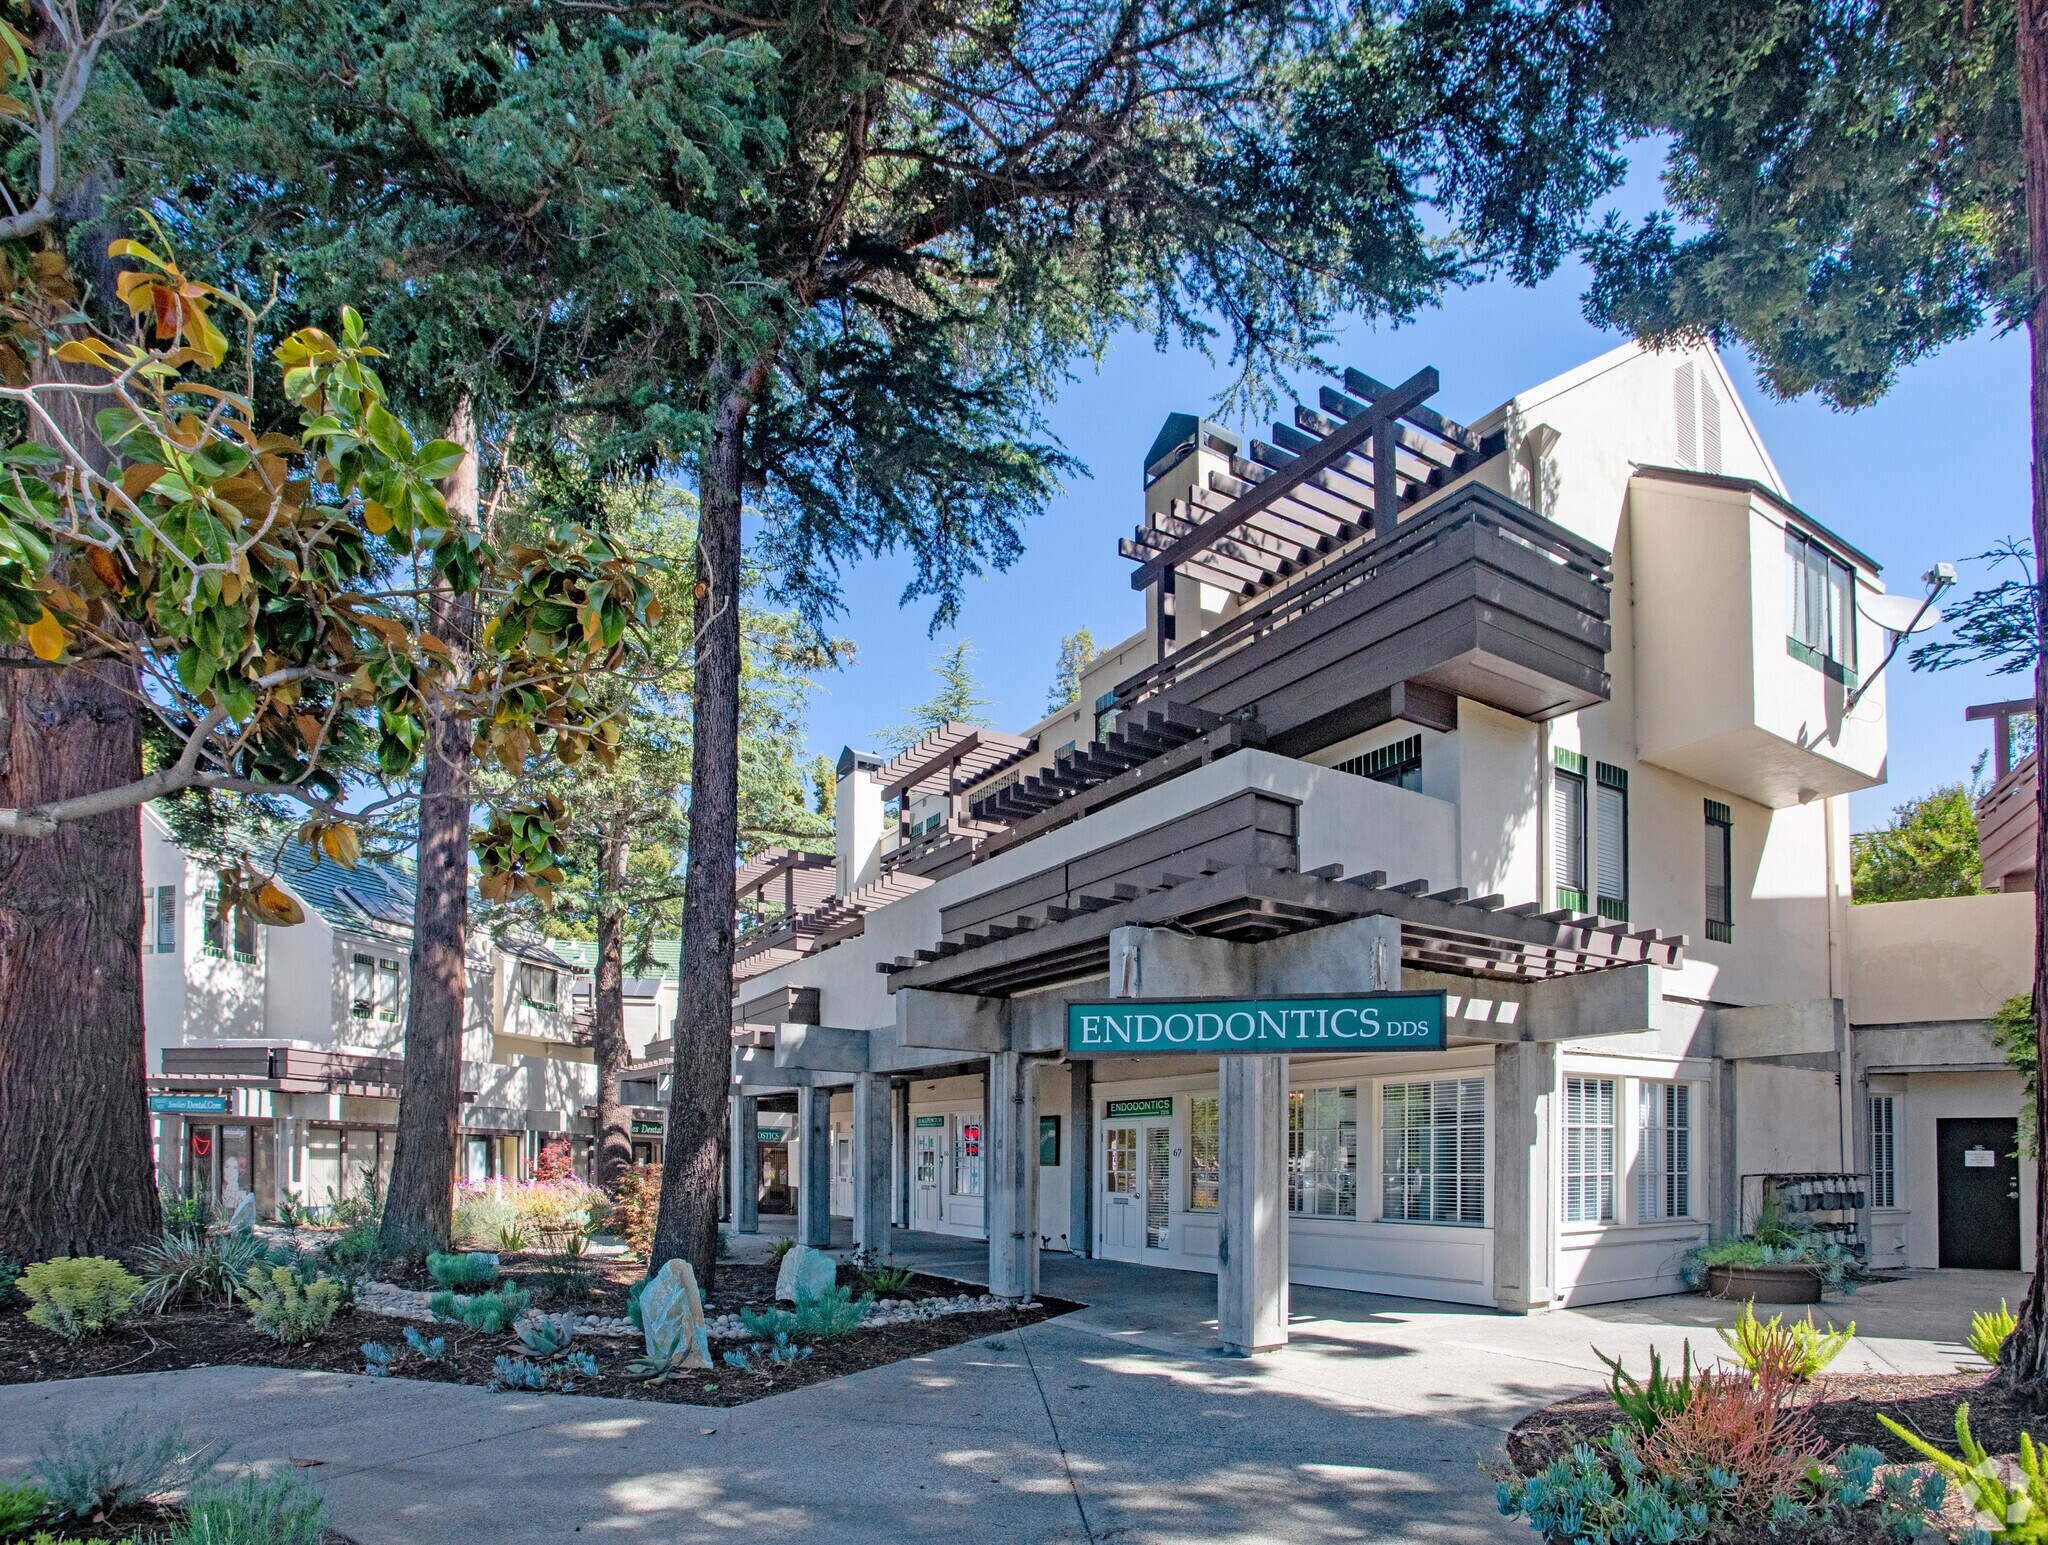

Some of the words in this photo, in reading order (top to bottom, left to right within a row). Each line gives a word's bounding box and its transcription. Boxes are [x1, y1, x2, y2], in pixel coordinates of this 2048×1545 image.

[1080, 1008, 1380, 1044] ENDODONTICS
[1387, 1021, 1429, 1037] DDS
[1110, 1100, 1170, 1112] ENDODONTICS
[641, 1124, 663, 1134] Dental
[1173, 1148, 1182, 1157] 67
